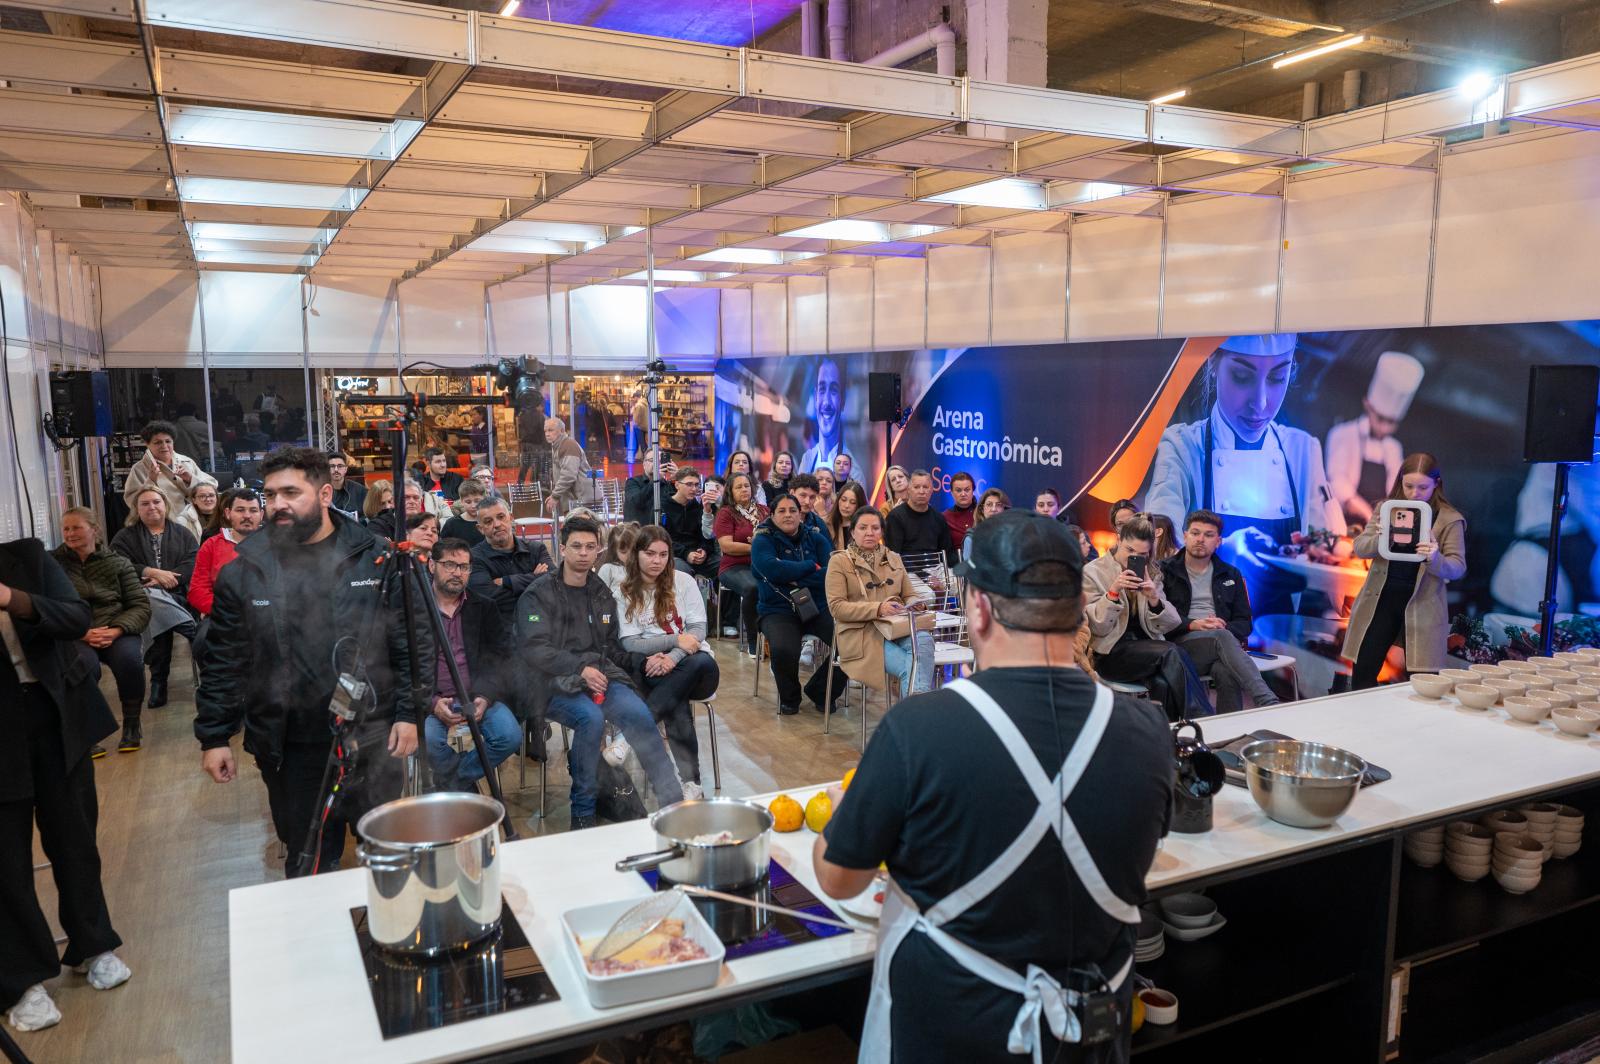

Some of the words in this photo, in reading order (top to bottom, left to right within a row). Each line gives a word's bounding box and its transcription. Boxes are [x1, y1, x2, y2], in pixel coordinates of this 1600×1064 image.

[932, 405, 984, 430] Arena
[932, 432, 1063, 467] Gastronômica
[931, 466, 988, 500] Sec
